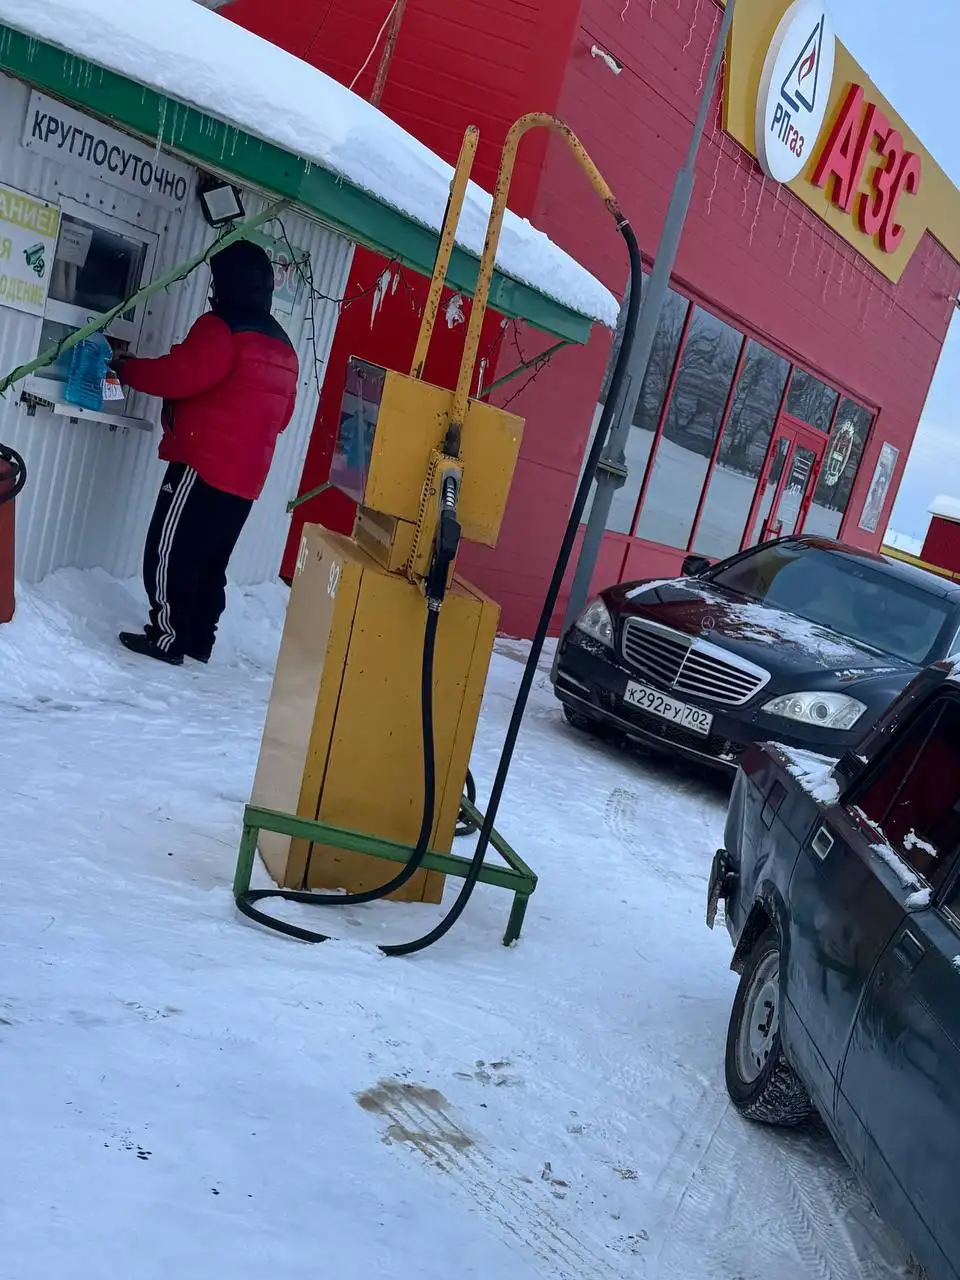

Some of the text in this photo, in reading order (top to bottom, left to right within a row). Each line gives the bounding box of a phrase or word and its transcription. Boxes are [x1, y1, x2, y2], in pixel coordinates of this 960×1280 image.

[31, 109, 187, 202] КРУГЛОСУТОЧНО
[770, 101, 805, 158] РПгаз
[810, 82, 921, 254] АГЗС
[327, 561, 340, 599] 92
[684, 706, 708, 726] 702
